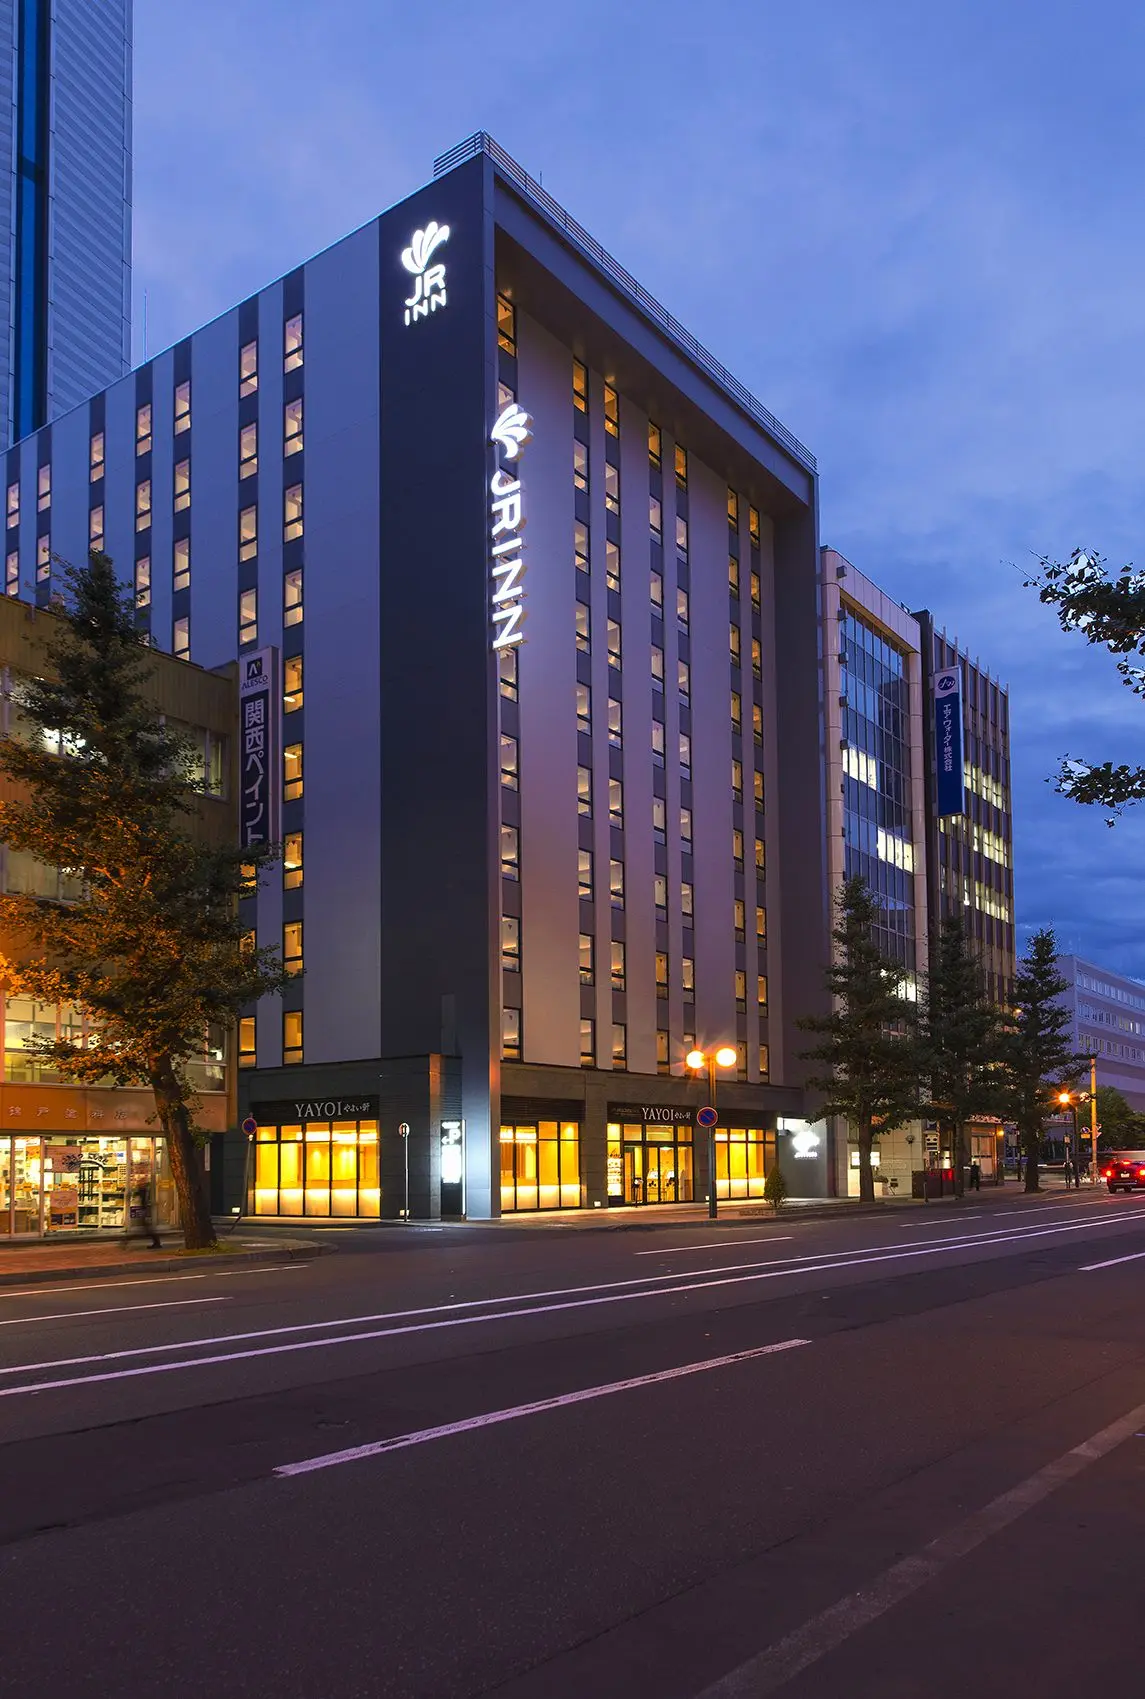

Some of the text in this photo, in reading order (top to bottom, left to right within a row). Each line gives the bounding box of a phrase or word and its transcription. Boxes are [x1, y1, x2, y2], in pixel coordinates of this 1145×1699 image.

[404, 264, 446, 306] JR
[404, 289, 447, 327] INN
[242, 674, 268, 690] ALESCO
[245, 699, 264, 848] 関西ペイント
[296, 1102, 342, 1117] YAYOI
[642, 1108, 674, 1121] YAYOI
